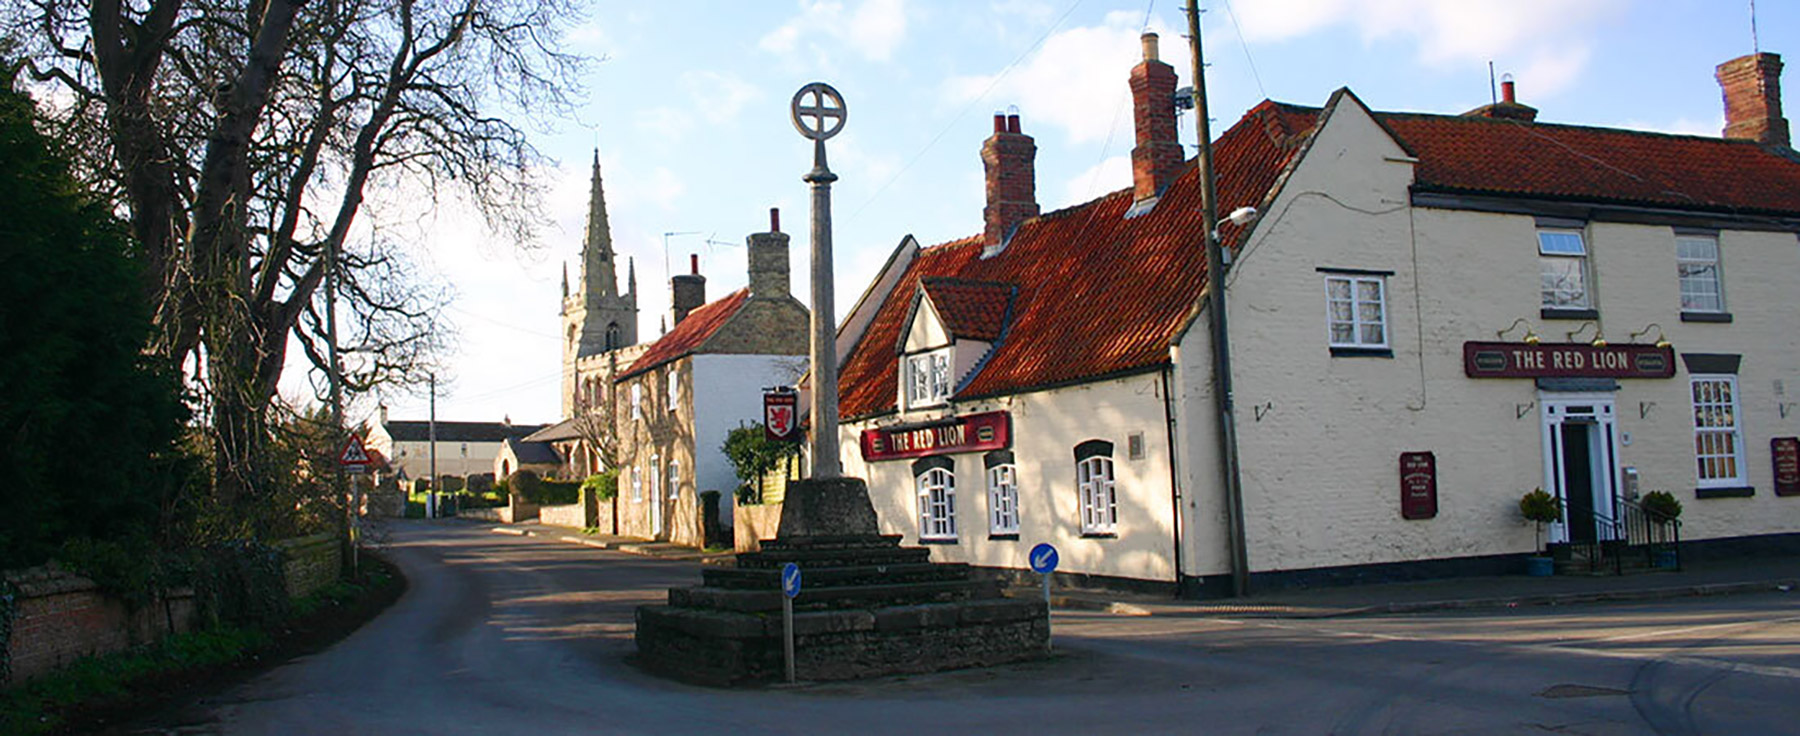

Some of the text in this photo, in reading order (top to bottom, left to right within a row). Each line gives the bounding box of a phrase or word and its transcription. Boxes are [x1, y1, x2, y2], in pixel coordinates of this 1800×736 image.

[1513, 351, 1629, 370] THE RED LION
[890, 424, 966, 451] THE RED LION
